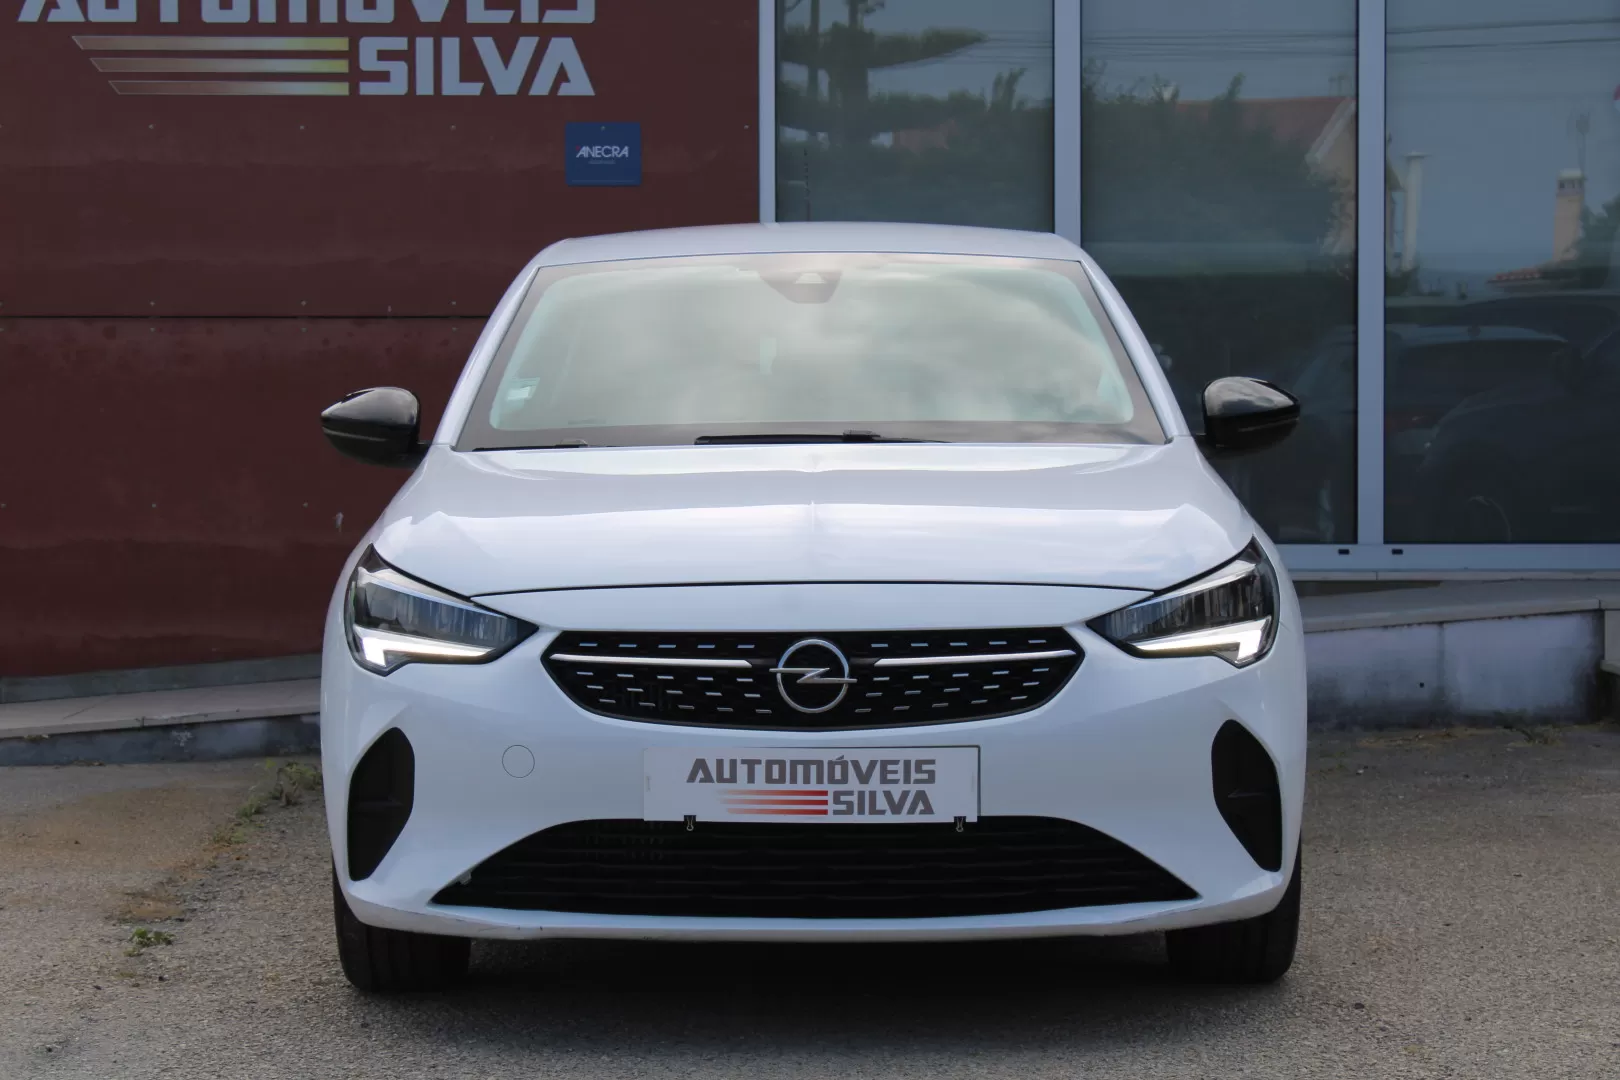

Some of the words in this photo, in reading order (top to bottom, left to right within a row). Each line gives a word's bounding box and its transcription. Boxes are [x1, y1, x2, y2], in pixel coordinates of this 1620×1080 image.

[358, 36, 596, 96] SILVA
[576, 145, 629, 158] ANECRA
[686, 755, 936, 785] AUTOMÓVEIS
[832, 789, 936, 816] SILVA
